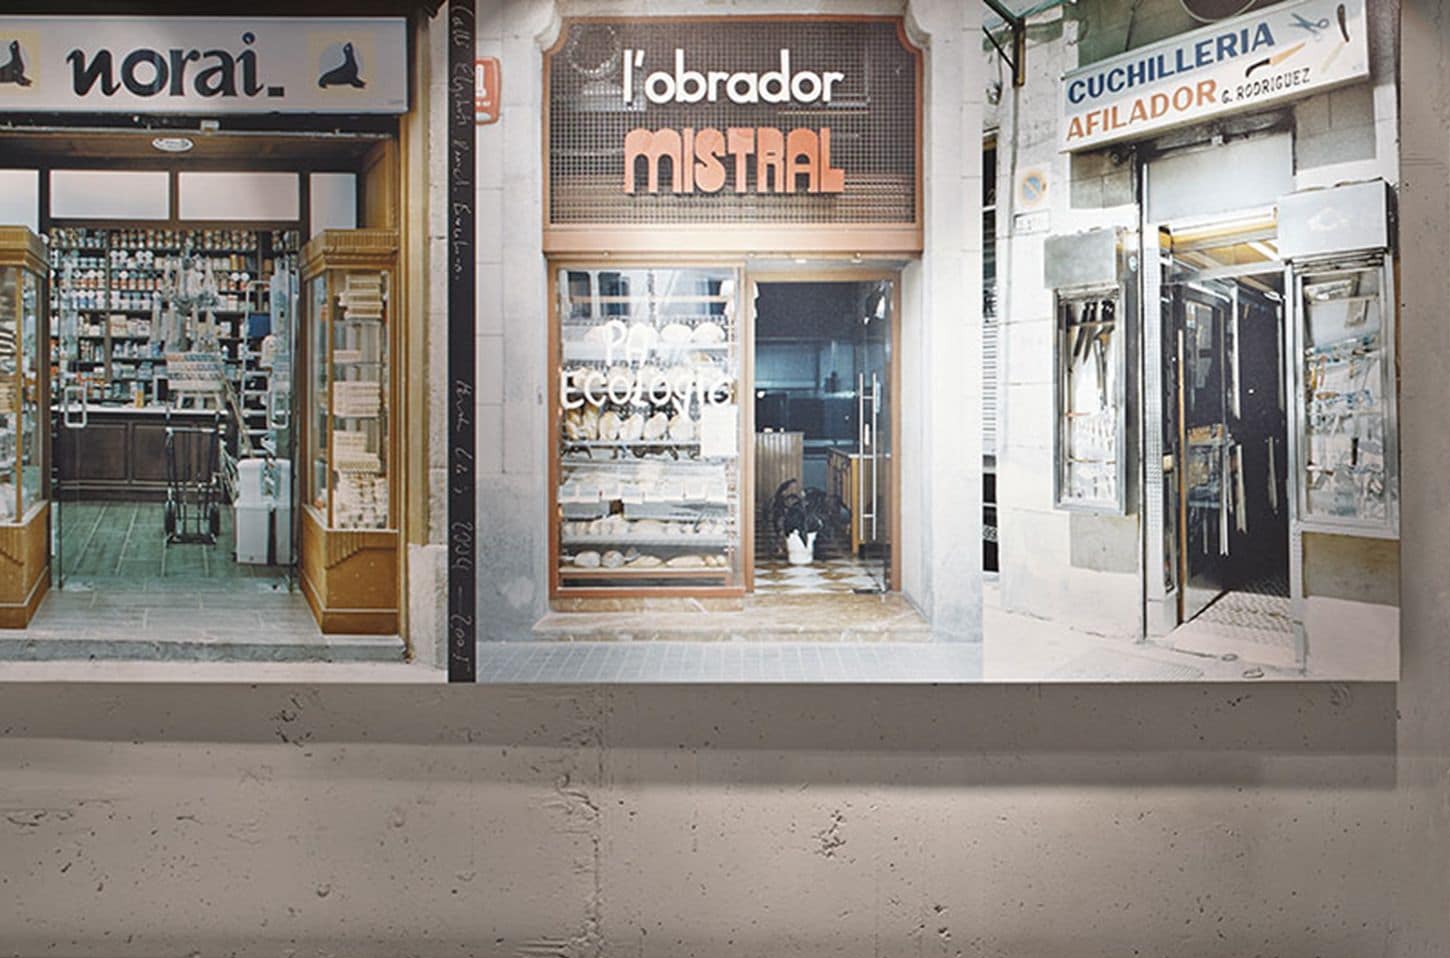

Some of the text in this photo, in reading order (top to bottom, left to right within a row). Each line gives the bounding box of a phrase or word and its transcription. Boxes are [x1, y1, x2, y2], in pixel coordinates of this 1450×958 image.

[623, 49, 844, 105] l'obrador
[1067, 22, 1276, 104] CUCHILLERIA
[1066, 67, 1311, 141] AFILADOR G. RODRIGUEZ
[624, 127, 846, 194] MISTRAL
